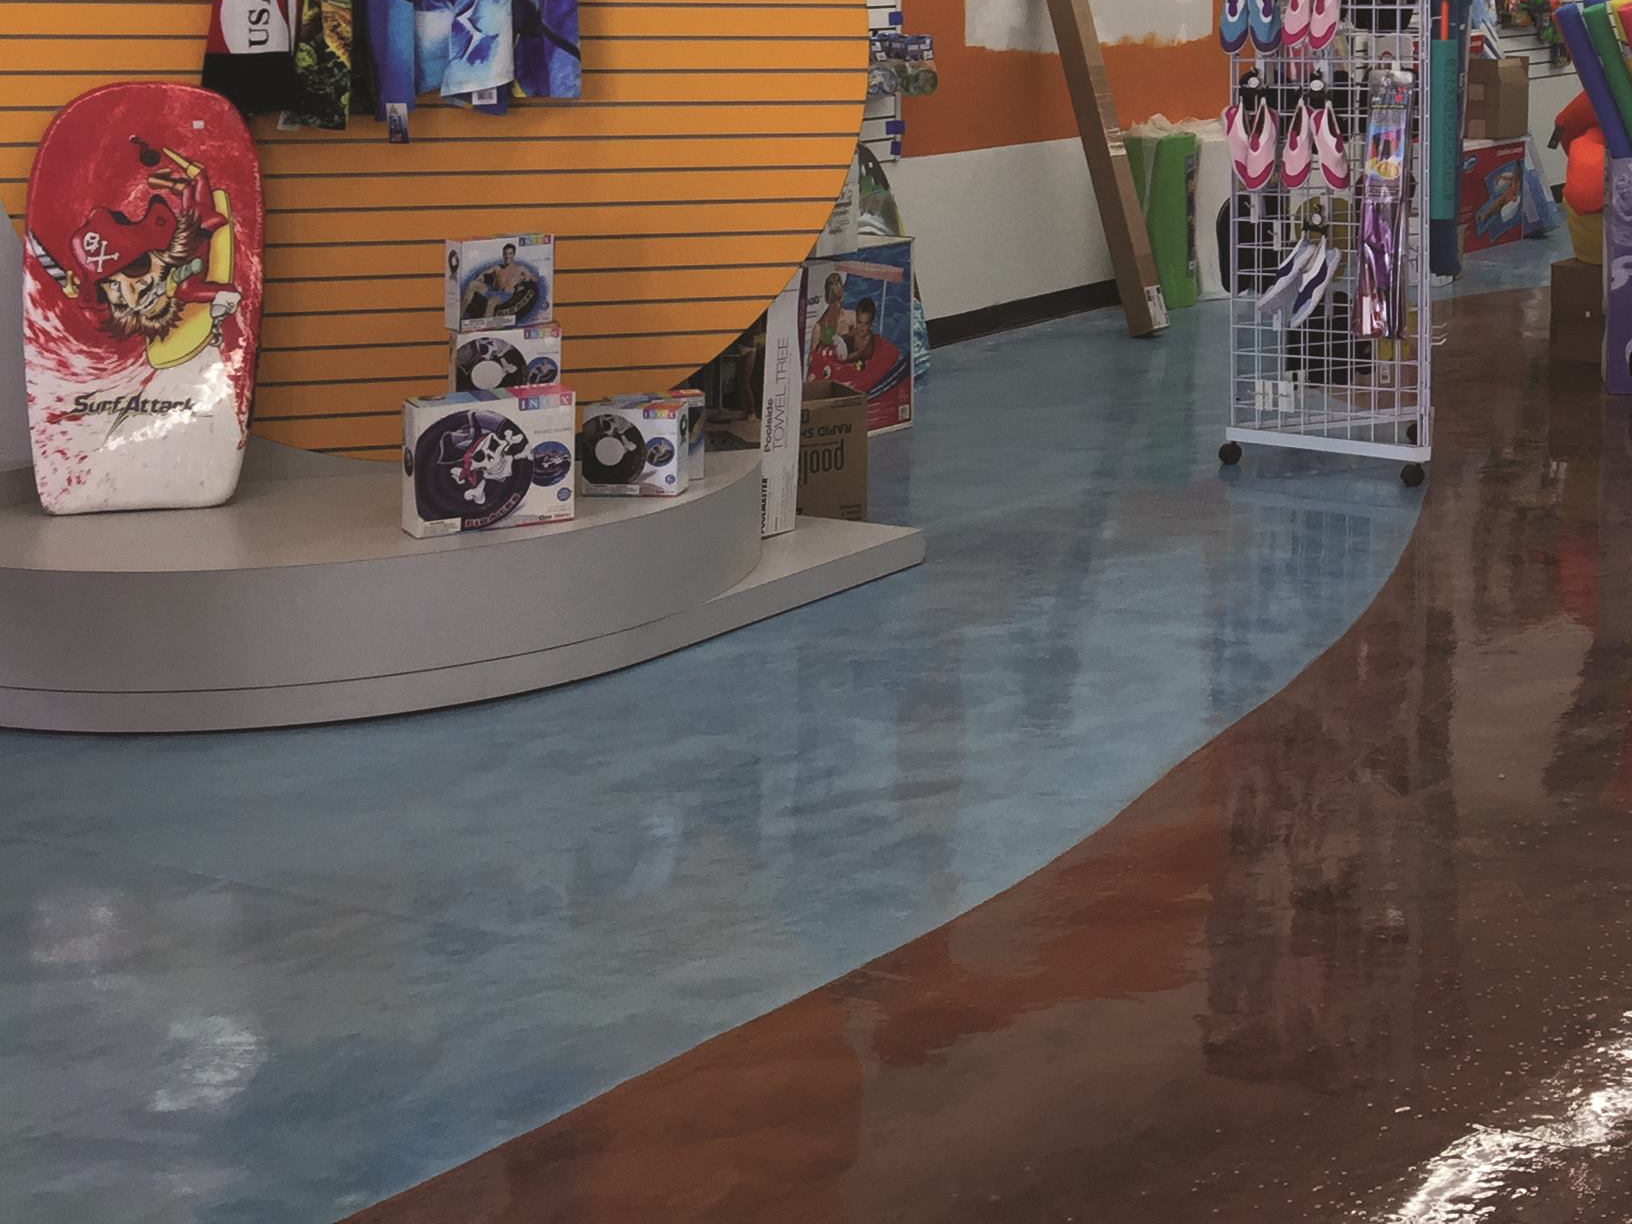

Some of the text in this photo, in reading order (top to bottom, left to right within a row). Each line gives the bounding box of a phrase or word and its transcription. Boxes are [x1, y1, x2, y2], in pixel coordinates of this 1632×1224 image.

[763, 397, 774, 453] Poolside
[772, 337, 789, 450] TOWEL TREE
